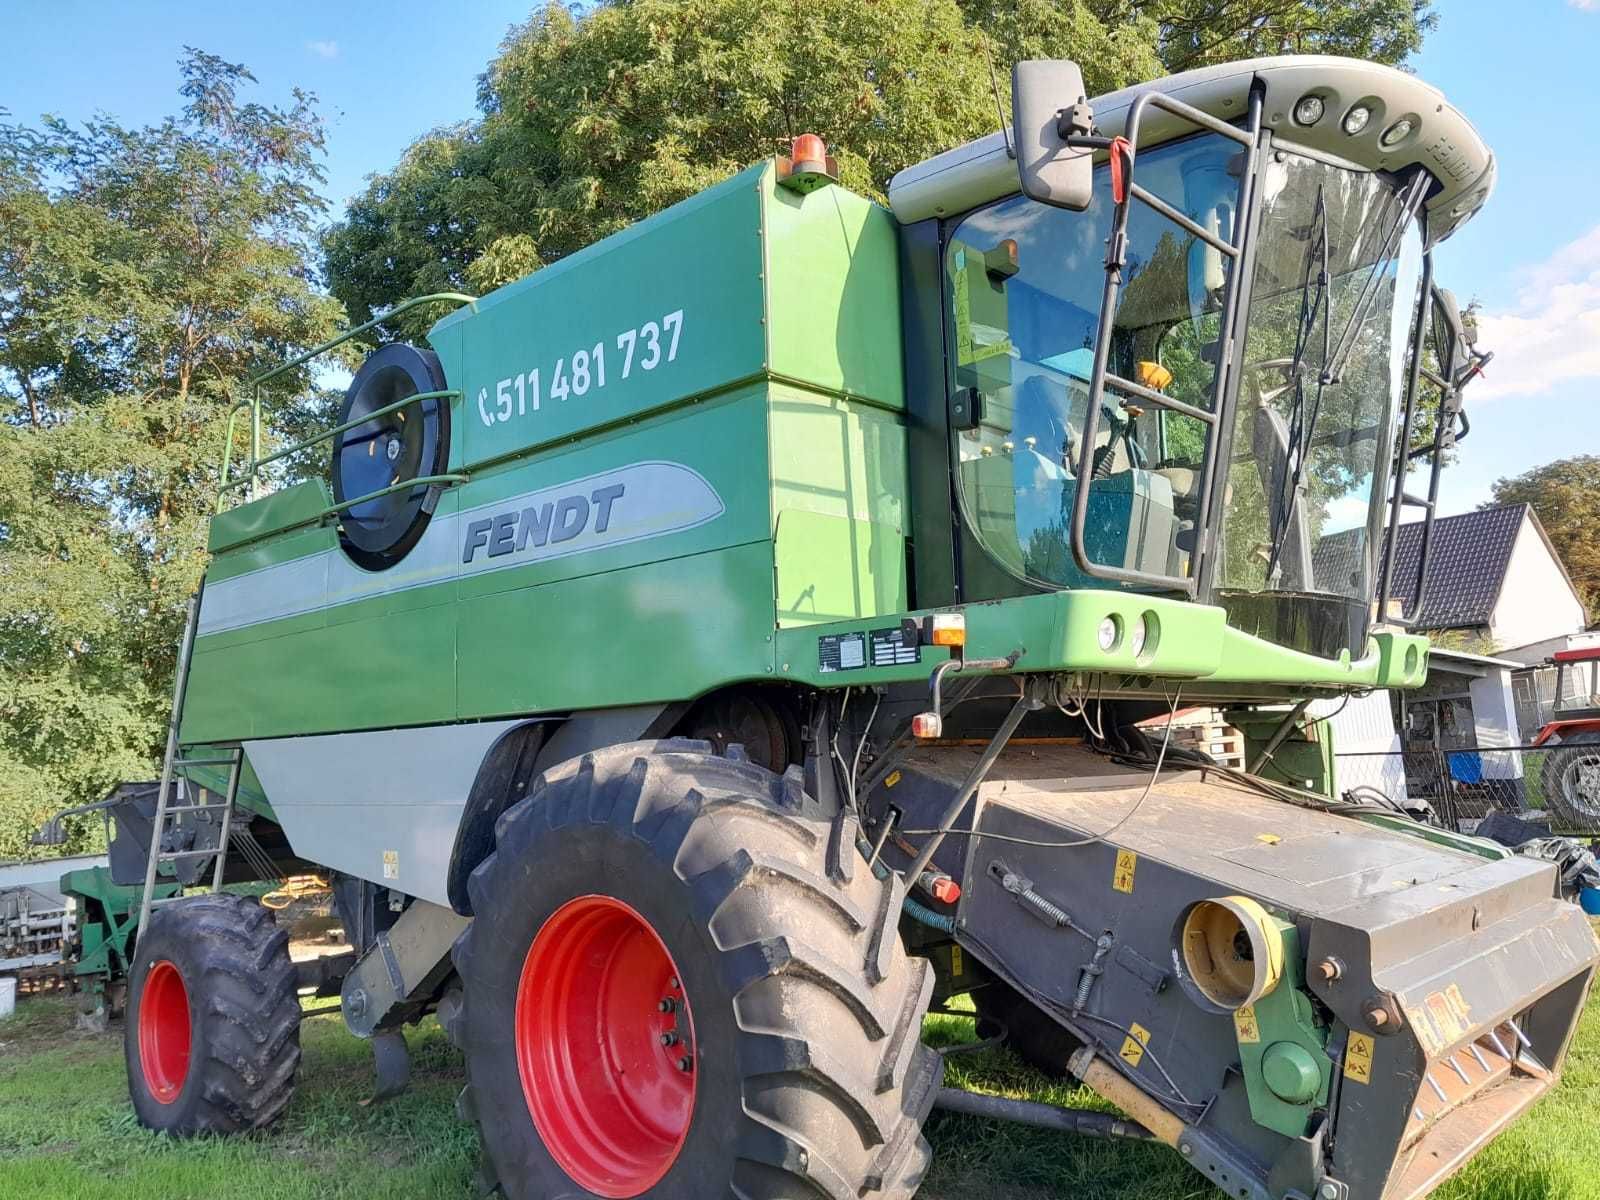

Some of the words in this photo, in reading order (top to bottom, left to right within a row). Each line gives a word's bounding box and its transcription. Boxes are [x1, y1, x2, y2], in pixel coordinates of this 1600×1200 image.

[494, 367, 540, 425] 511
[550, 341, 606, 402] 481
[617, 309, 684, 379] 737
[462, 483, 625, 564] FENDT
